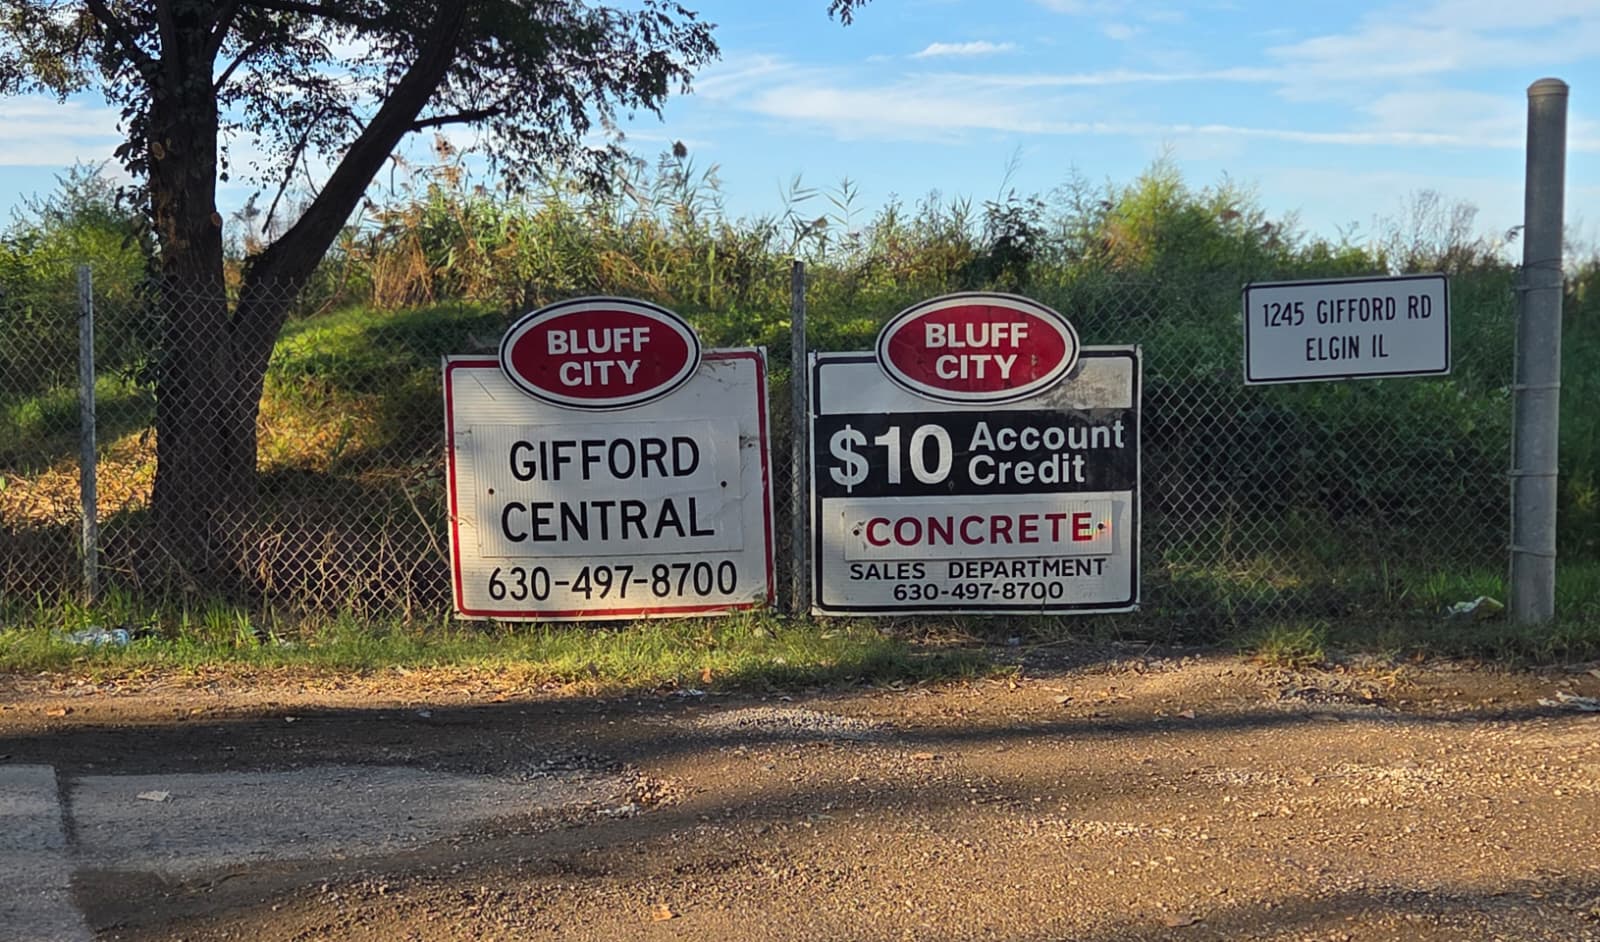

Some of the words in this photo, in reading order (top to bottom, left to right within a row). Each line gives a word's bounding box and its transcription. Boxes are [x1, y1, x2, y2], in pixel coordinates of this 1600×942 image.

[1263, 301, 1305, 327] 1245
[1317, 297, 1396, 325] GIFFORD
[1408, 294, 1432, 319] RD
[547, 327, 650, 355] BLUFF
[925, 322, 1028, 349] BLUFF
[1306, 335, 1360, 361] ELGIN
[1372, 334, 1389, 358] IL
[559, 360, 641, 387] CITY
[935, 354, 1018, 380] CITY
[968, 420, 1125, 451] Account
[510, 436, 700, 481] GIFFORD
[829, 424, 953, 493] $10
[968, 453, 1086, 486] Credit
[501, 497, 715, 542] CENTRAL
[865, 512, 1093, 547] CONCRETE
[488, 560, 737, 600] 630-497-8700
[849, 562, 926, 580] SALES
[948, 558, 1107, 579] DEPARTMENT
[893, 581, 1064, 601] 630-497-8700
